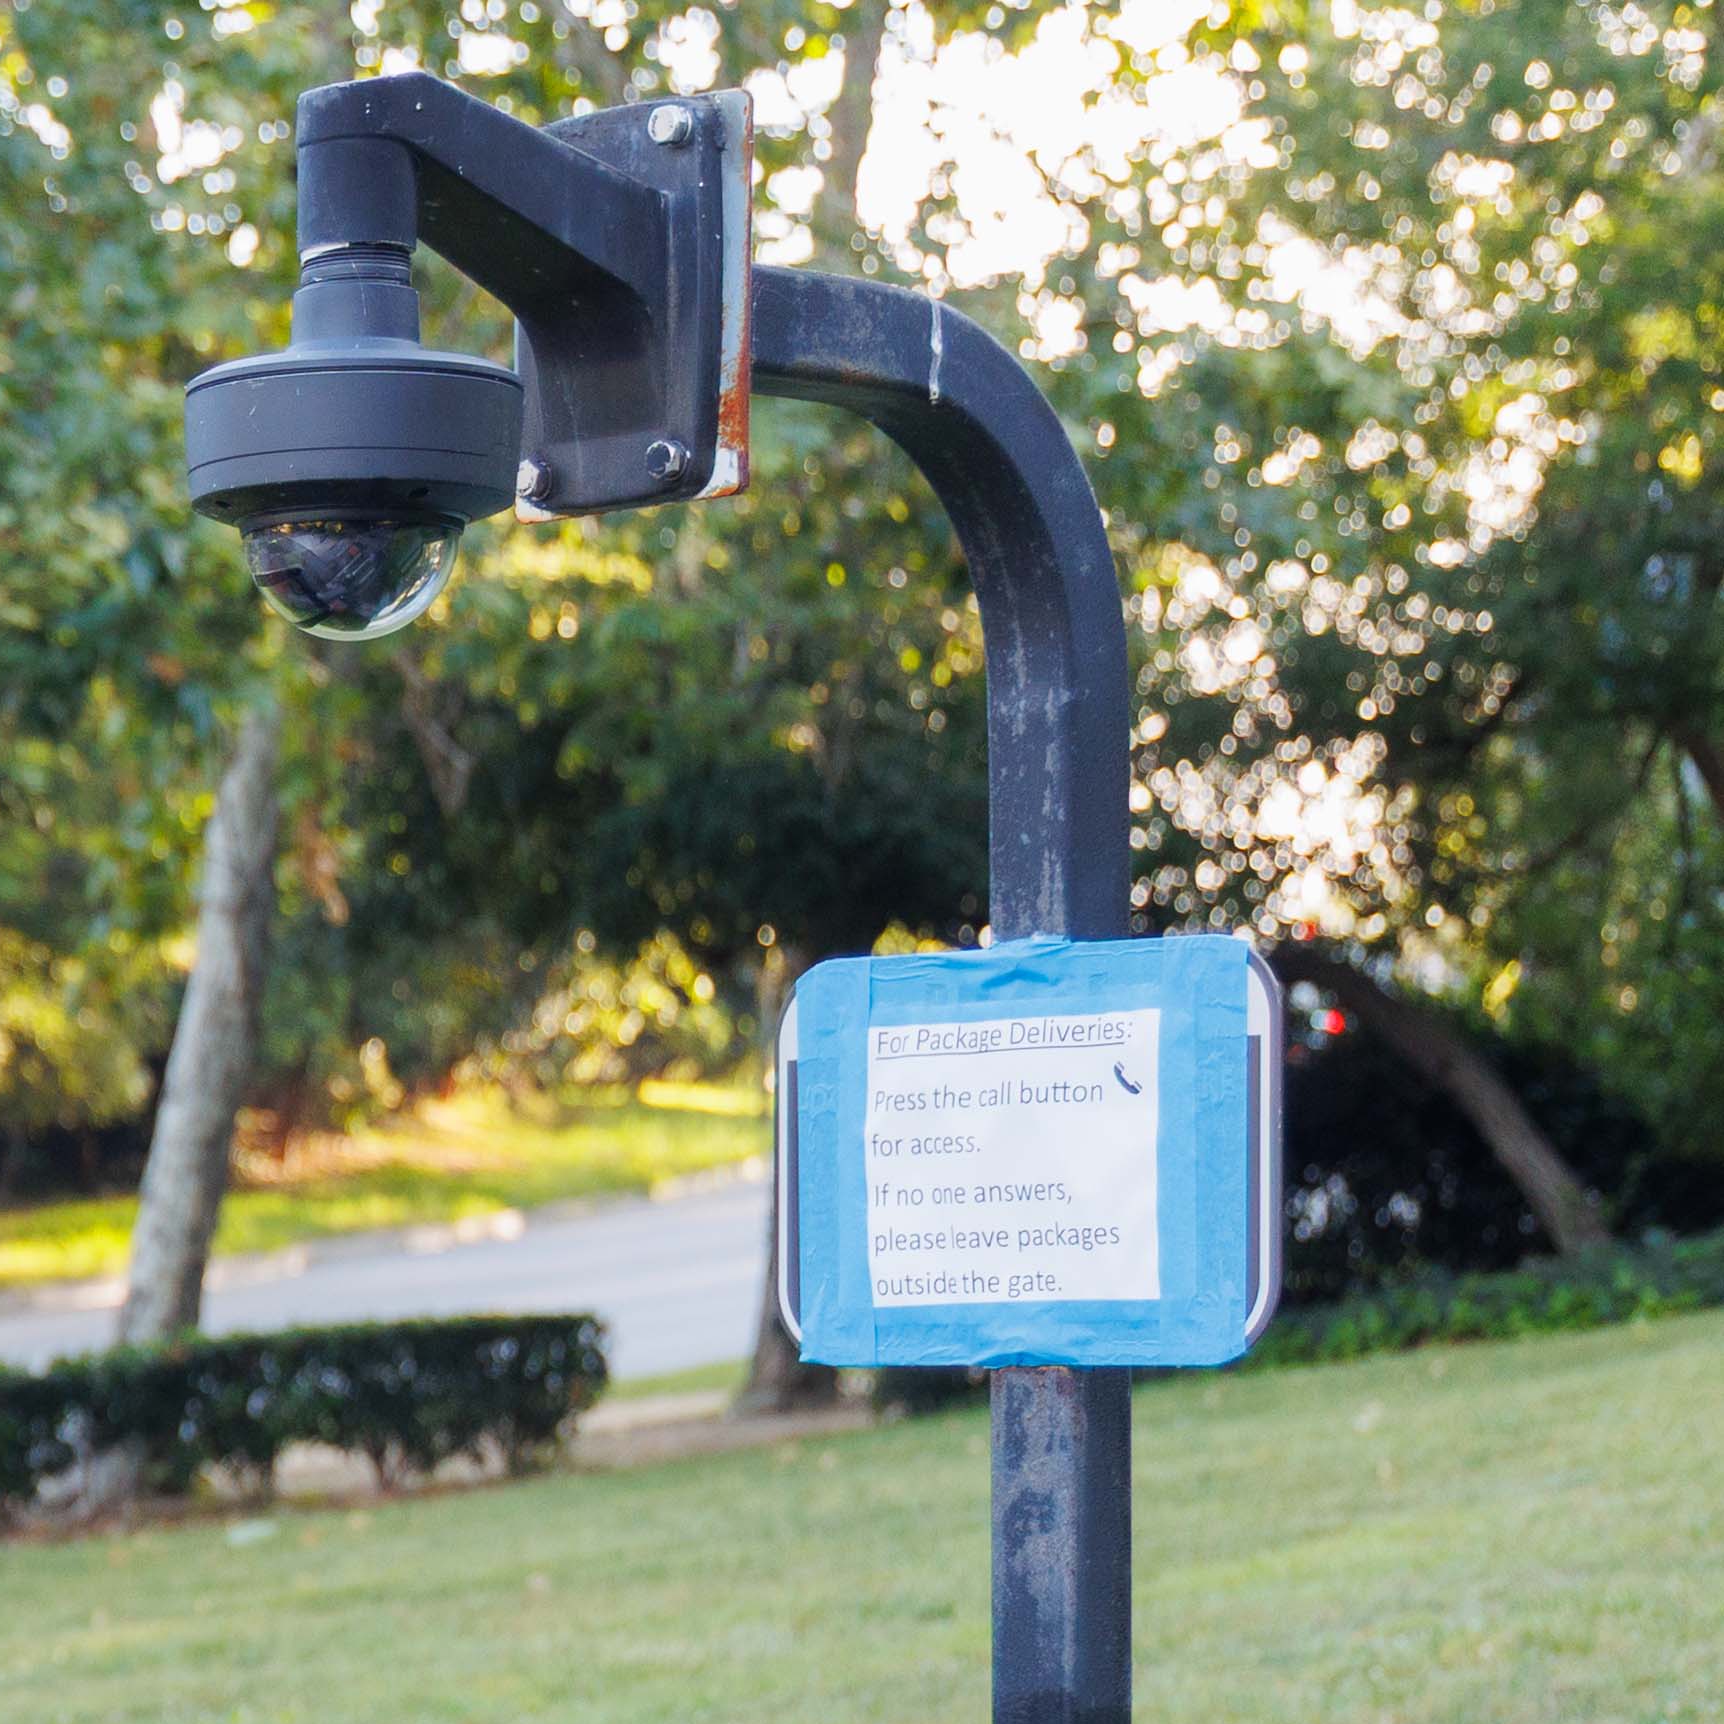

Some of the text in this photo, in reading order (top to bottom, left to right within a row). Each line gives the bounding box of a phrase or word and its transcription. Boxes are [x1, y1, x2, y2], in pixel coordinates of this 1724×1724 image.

[877, 1017, 1133, 1054] For Package Deliveries:
[873, 1080, 1103, 1112] Press the call button
[871, 1134, 981, 1157] for access.
[874, 1181, 1072, 1207] If no one answers,
[874, 1222, 1120, 1256] please leave packages
[876, 1270, 1062, 1298] outside the gate.
